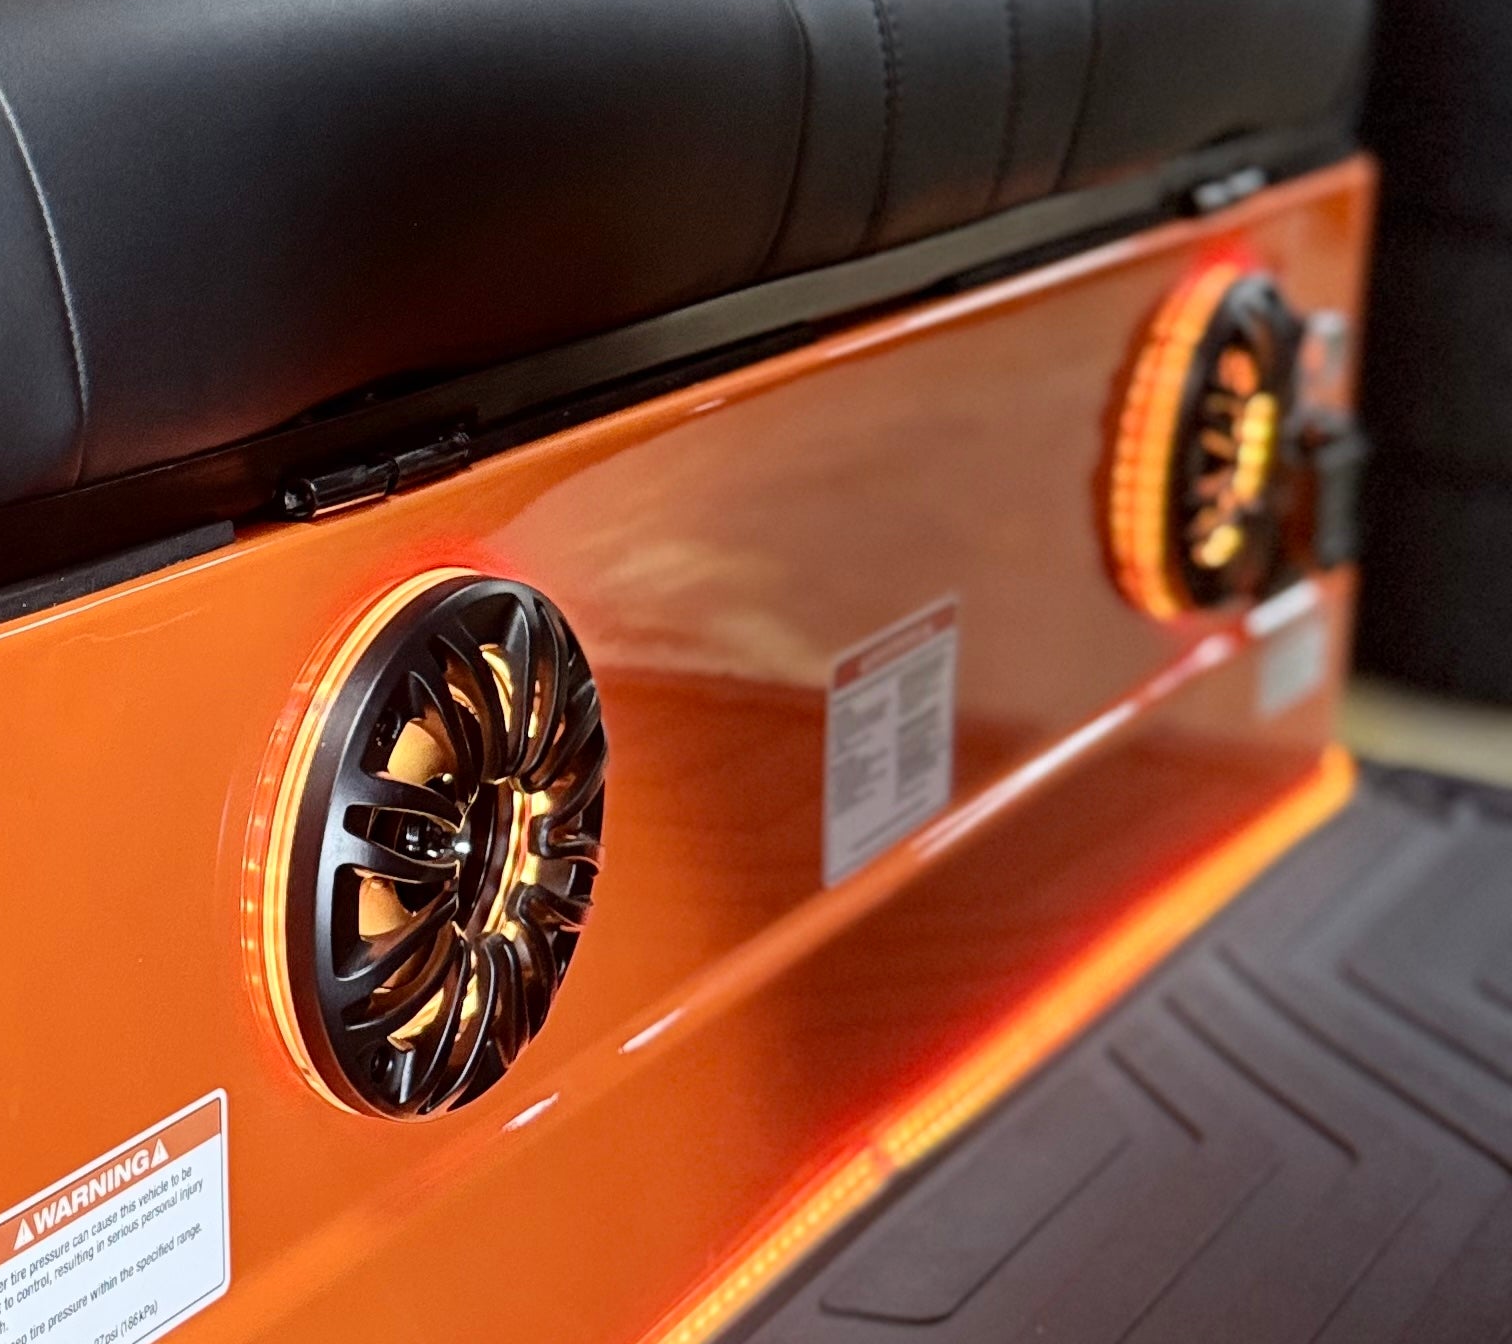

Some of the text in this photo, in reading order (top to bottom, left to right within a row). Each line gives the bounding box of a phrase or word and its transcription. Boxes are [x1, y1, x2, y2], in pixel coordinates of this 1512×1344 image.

[4, 1296, 14, 1311] to
[16, 1272, 53, 1304] control,
[55, 1246, 94, 1280] resulting
[97, 1239, 105, 1254] in
[107, 1218, 139, 1247] serious
[141, 1191, 178, 1229] personal
[179, 1178, 203, 1201] injury
[10, 1267, 27, 1286] tire
[29, 1241, 70, 1278] pressure
[73, 1229, 89, 1247] can
[91, 1212, 118, 1236] cause
[120, 1200, 137, 1218] this
[138, 1180, 169, 1207] vehicle
[171, 1174, 180, 1188] to
[182, 1166, 192, 1181] be
[33, 1149, 150, 1235] WARNING
[30, 1322, 46, 1341] tire
[48, 1295, 88, 1331] pressure
[90, 1276, 118, 1301] within
[120, 1265, 134, 1282] the
[136, 1236, 175, 1272] specified
[176, 1223, 202, 1246] range.
